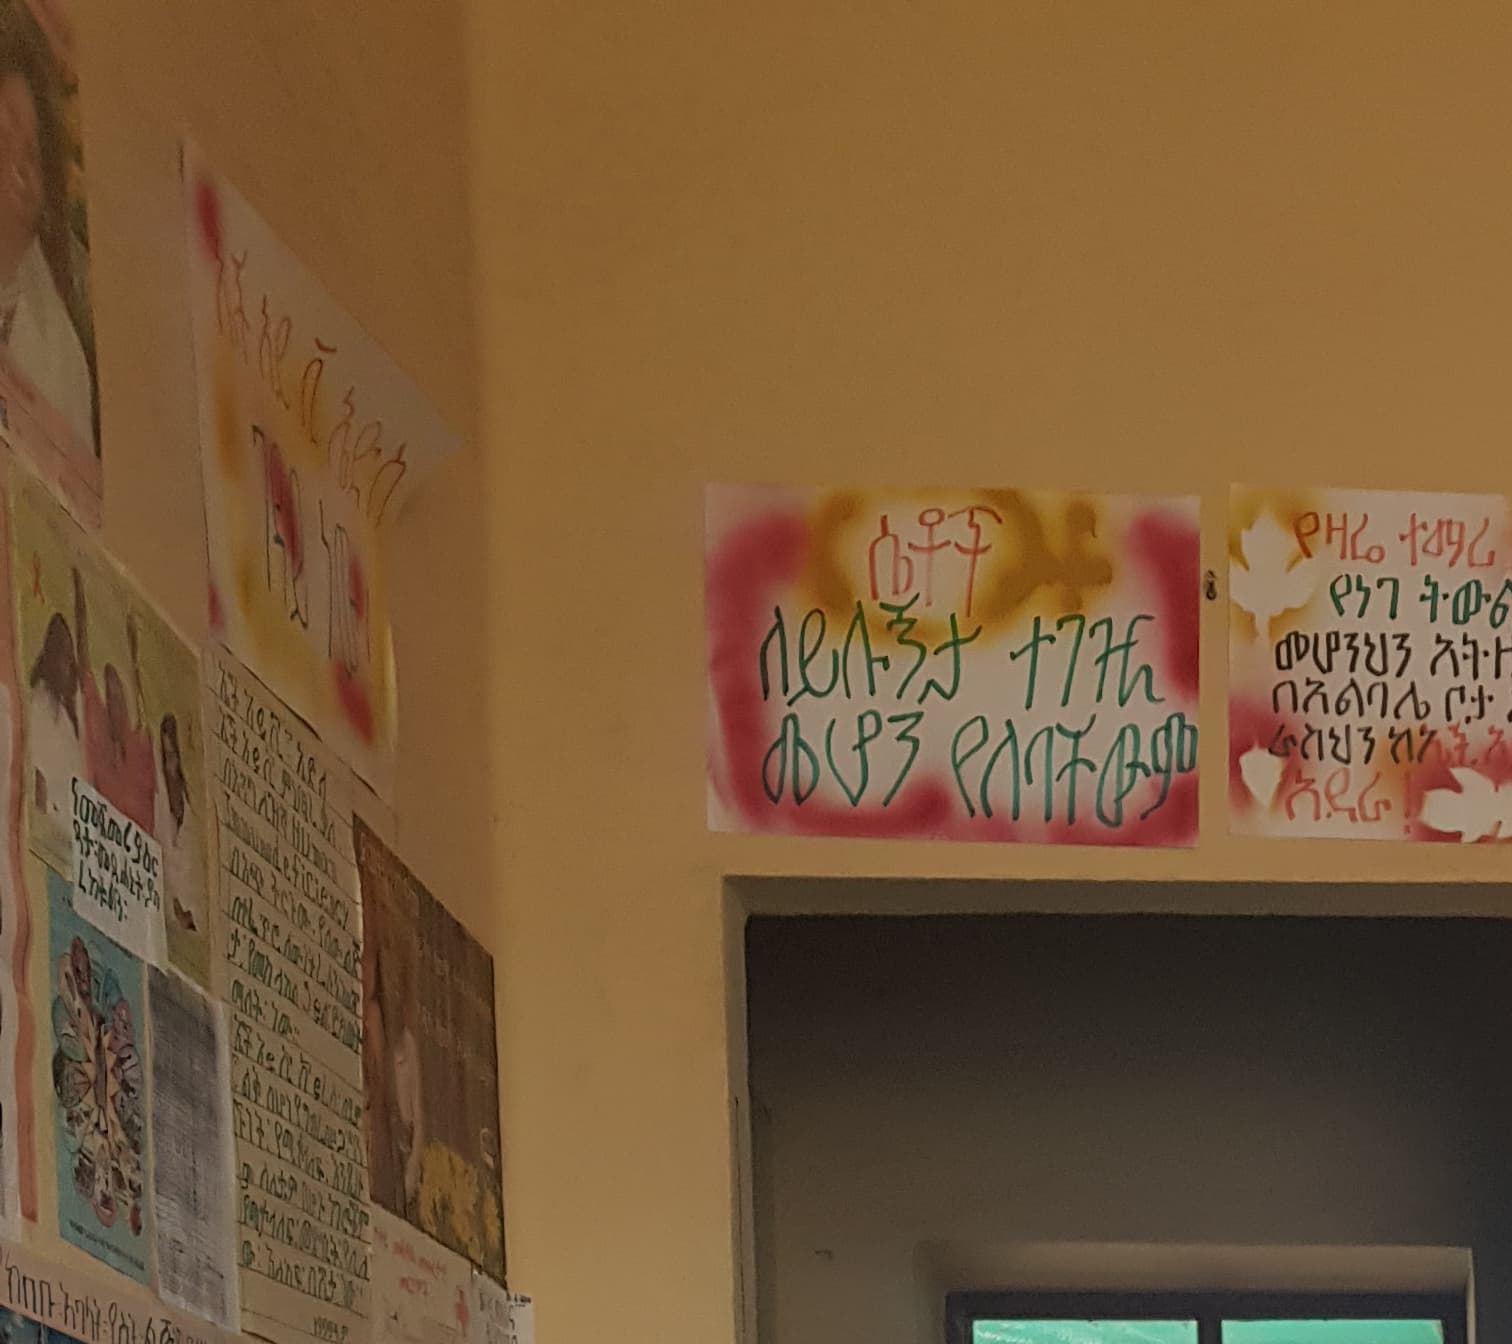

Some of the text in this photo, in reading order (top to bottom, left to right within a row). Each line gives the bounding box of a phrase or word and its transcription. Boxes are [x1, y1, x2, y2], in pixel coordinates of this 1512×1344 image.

[869, 507, 1002, 618] ሴቶች
[1293, 511, 1496, 568] የዛሬ ተማሪ
[1329, 573, 1399, 620] የነገ
[760, 593, 1165, 710] ለይሉኝታ ተገዢ
[1275, 629, 1411, 678] መሆንህን
[762, 711, 1198, 827] መሆን የለባቸውም
[1268, 725, 1376, 765] ራስህን
